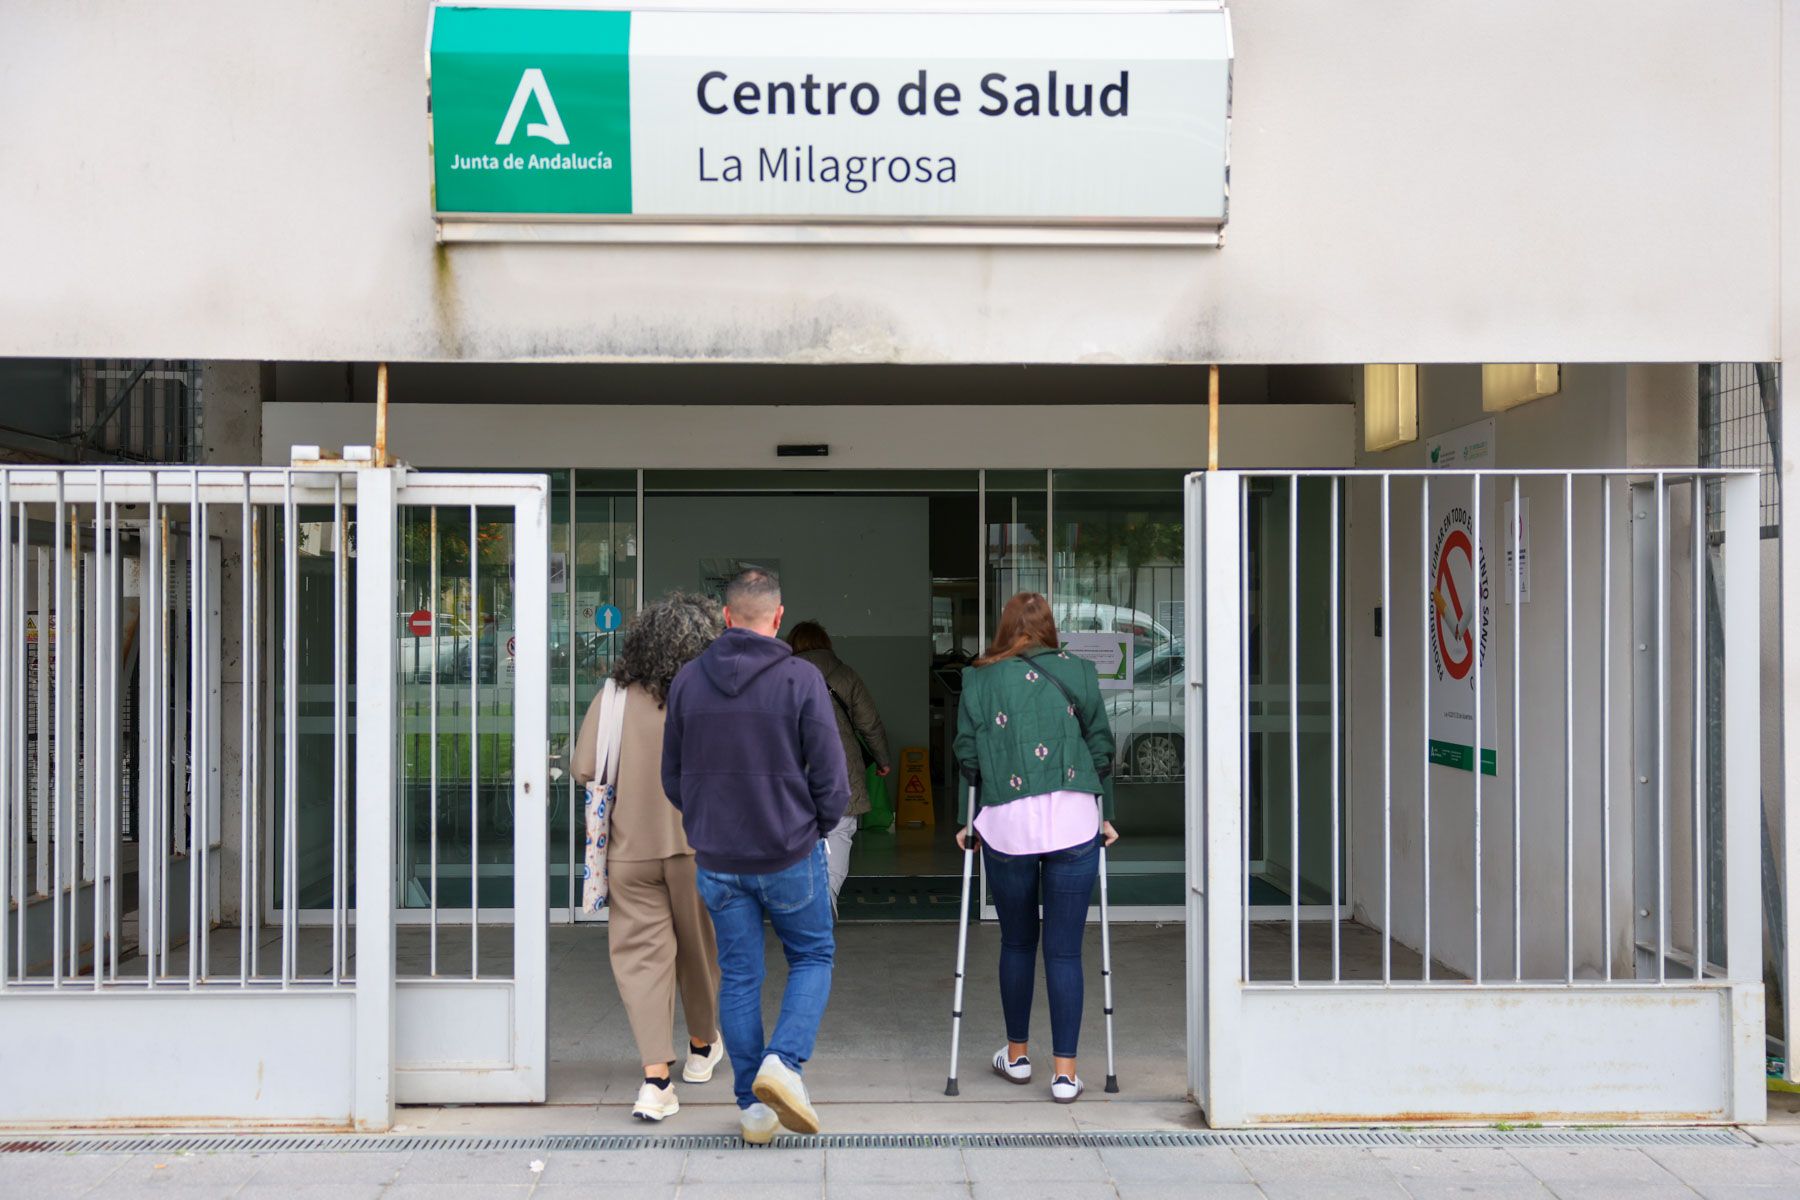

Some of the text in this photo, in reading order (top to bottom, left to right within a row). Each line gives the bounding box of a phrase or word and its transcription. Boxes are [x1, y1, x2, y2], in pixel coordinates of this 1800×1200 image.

[696, 70, 1130, 119] Centro de Salud
[450, 151, 613, 170] Junta de Andalucía
[699, 144, 956, 194] La Milagrosa
[1443, 513, 1451, 532] EN
[1452, 507, 1467, 525] TODO
[1432, 527, 1445, 579] FUMAR
[1429, 591, 1444, 682] PROHIBIDO
